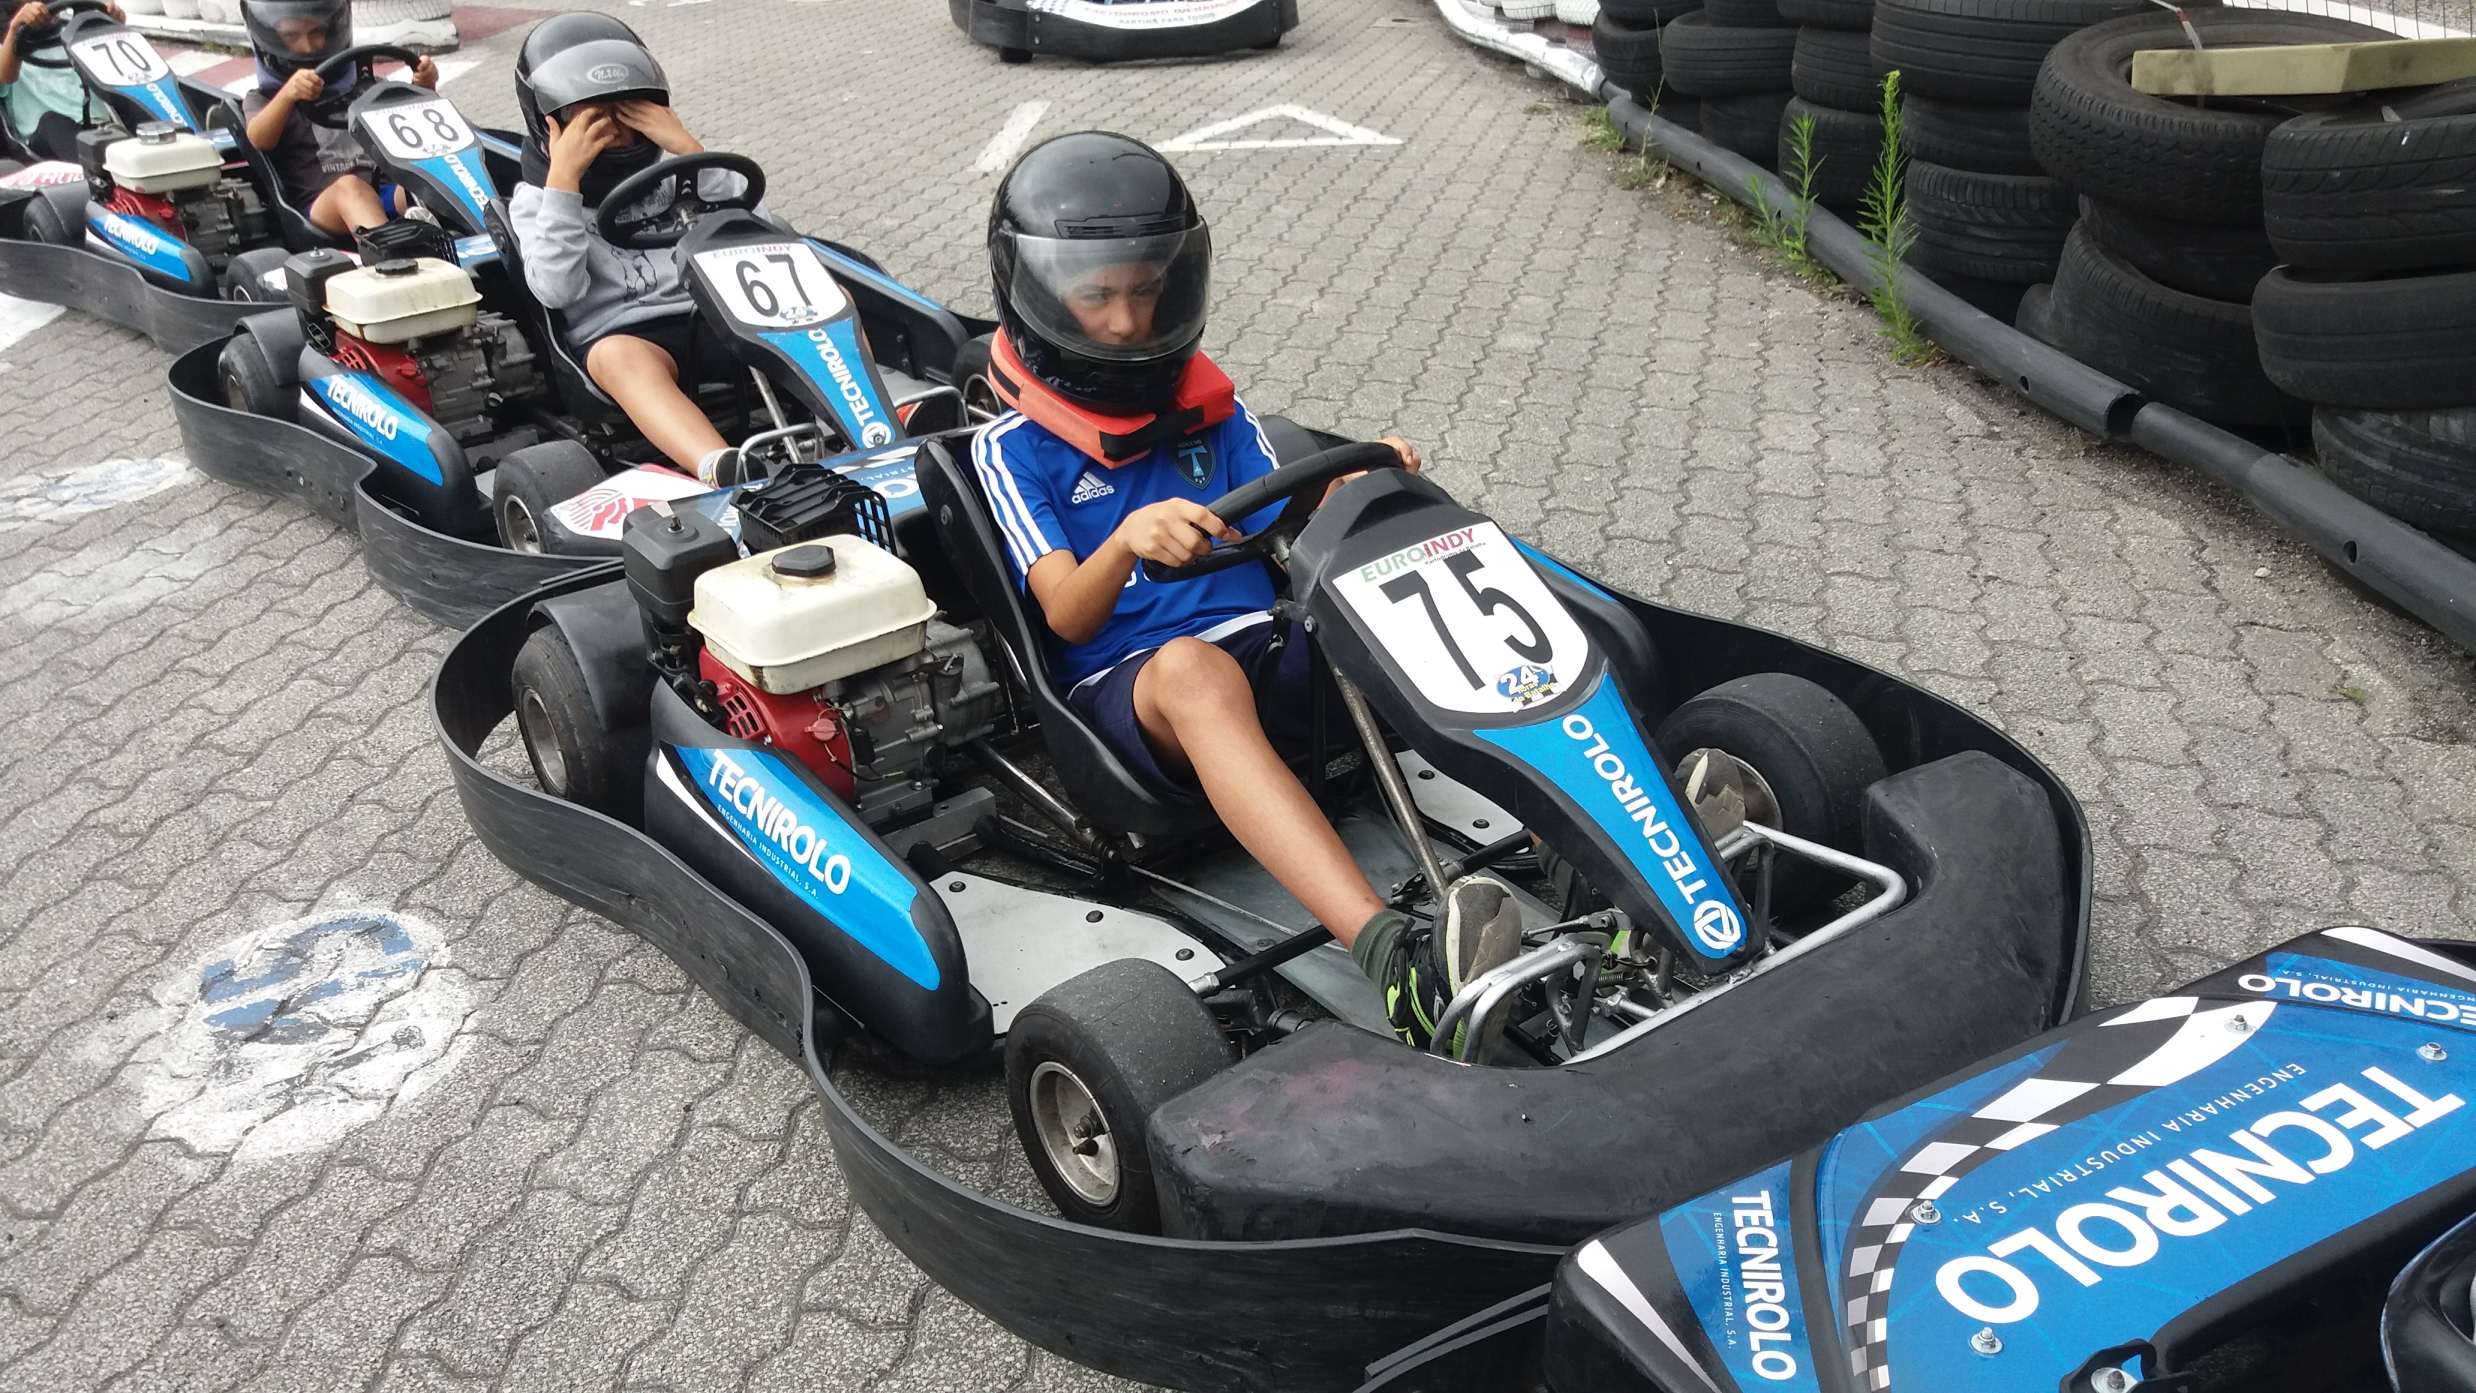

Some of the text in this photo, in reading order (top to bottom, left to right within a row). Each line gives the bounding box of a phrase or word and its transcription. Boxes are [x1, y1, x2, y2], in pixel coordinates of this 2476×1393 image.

[92, 40, 151, 76] 70
[389, 109, 459, 148] 68
[736, 254, 812, 318] 67
[328, 375, 399, 441] TECNIROLO
[808, 328, 874, 427] TECNIROLO
[1072, 485, 1115, 504] adidas
[1361, 528, 1474, 583] EUROINDY
[1378, 549, 1554, 691] 75
[1501, 665, 1539, 695] 24
[709, 748, 851, 895] TECNIROLO
[718, 804, 757, 845] ENGENHARIA
[759, 842, 802, 886] INDUSTRIAL,
[1562, 714, 1707, 905] TECNIROLO
[2308, 972, 2391, 991] INDUSTRIAL,
[2398, 985, 2476, 1003] NGENHARIA
[1953, 1062, 2307, 1226] ENGENHARIA INDUSTRIAL, S.A.
[1935, 1066, 2466, 1324] TECNIROLO
[1713, 1211, 1737, 1349] ENGENHARIA INDUSTRIAL, S.A.
[1731, 1190, 1797, 1381] TECNIROLO
